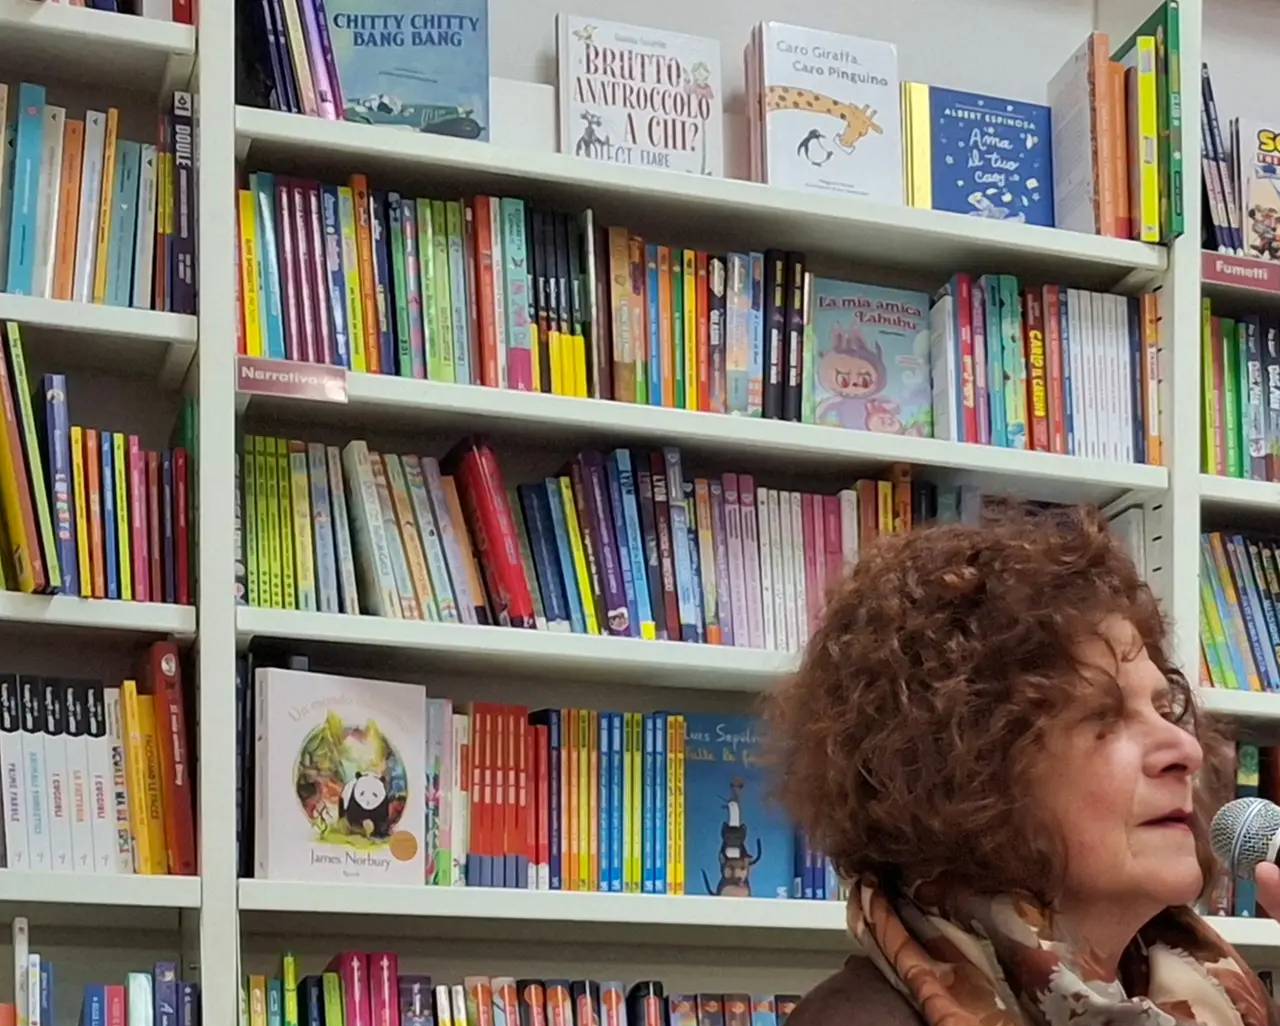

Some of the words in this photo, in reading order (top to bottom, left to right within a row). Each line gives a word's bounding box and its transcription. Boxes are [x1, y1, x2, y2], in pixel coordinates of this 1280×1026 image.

[333, 13, 404, 30] CHITTY
[410, 14, 480, 32] CHITTY
[353, 30, 405, 47] BANG
[410, 30, 462, 47] BANG
[584, 43, 682, 88] BRUTTO
[827, 67, 889, 88] Pinguino
[573, 76, 711, 121] ANATROCCOLO
[944, 108, 984, 124] ALBERT
[985, 114, 1036, 131] ESPINOSA
[624, 112, 637, 144] A
[647, 115, 699, 152] CHI?
[1215, 260, 1269, 281] Fumetti
[848, 297, 877, 314] mia
[880, 301, 924, 319] amica
[653, 475, 667, 501] LYON
[310, 848, 343, 868] James
[345, 850, 392, 870] Norbury
